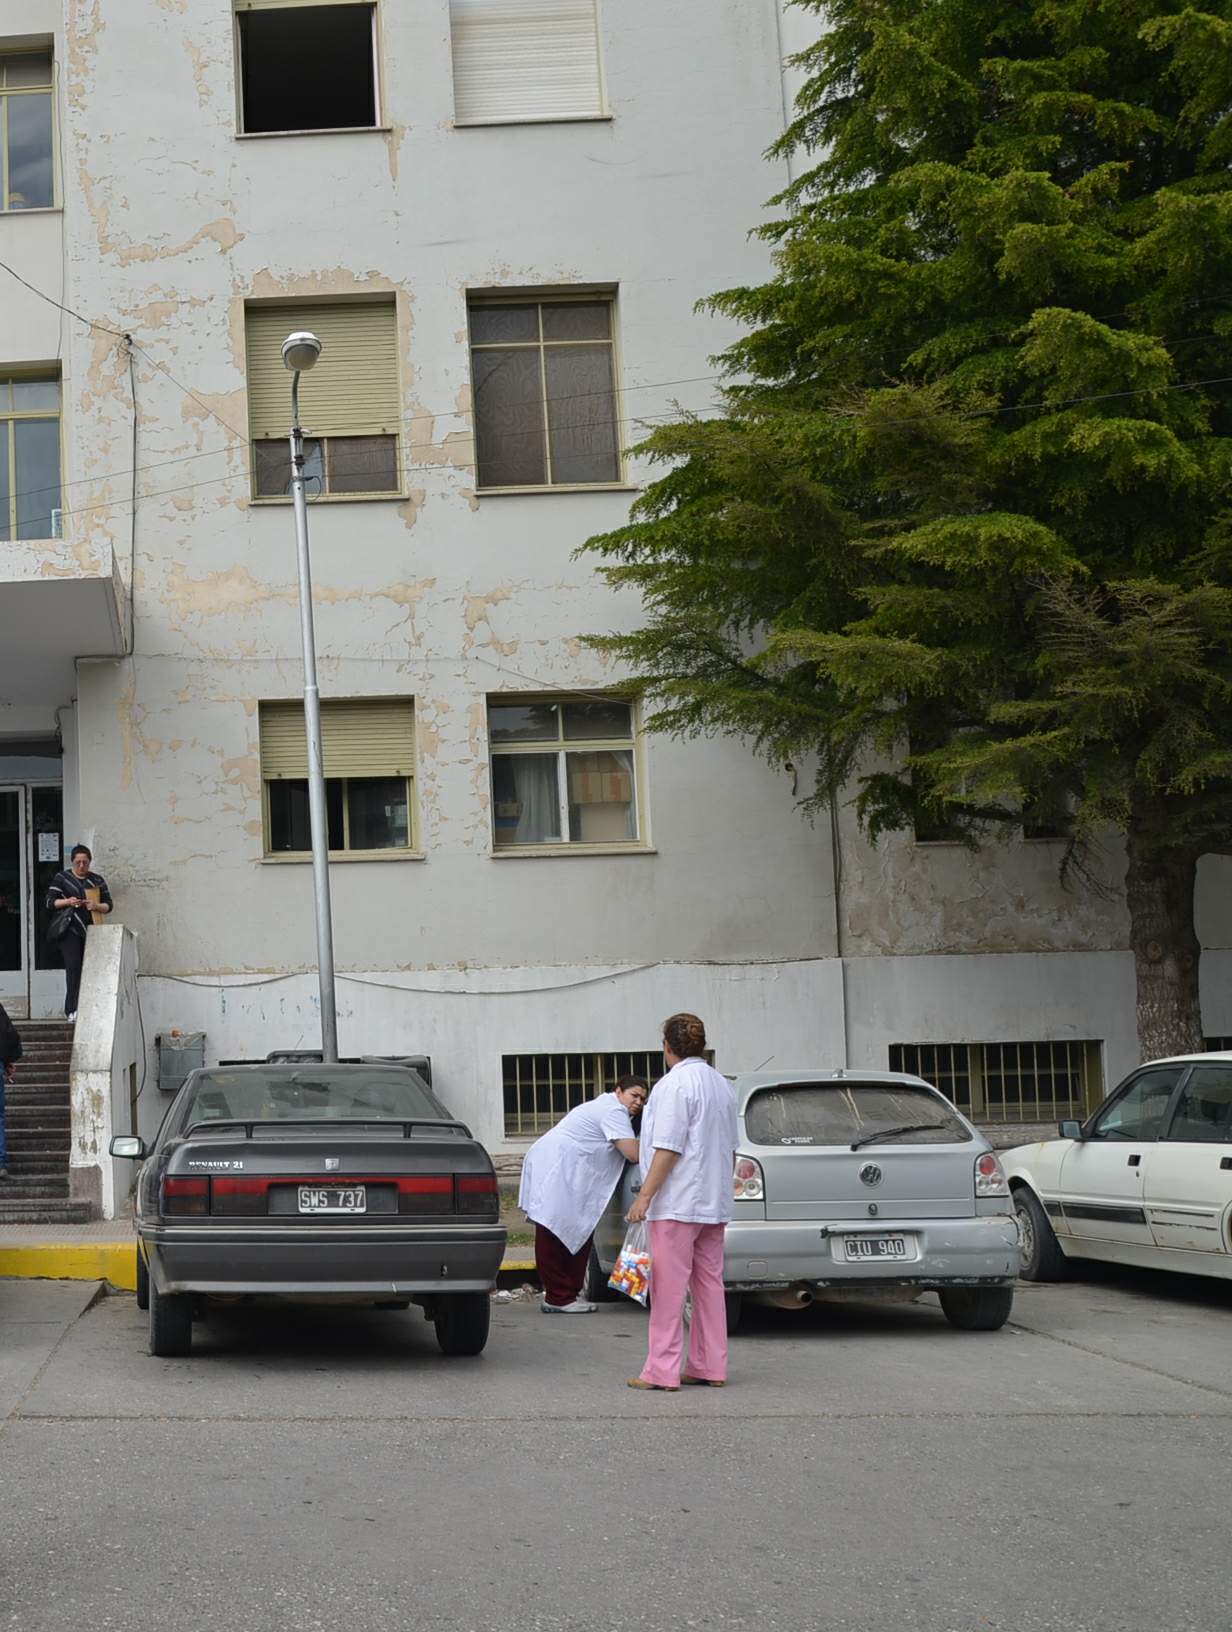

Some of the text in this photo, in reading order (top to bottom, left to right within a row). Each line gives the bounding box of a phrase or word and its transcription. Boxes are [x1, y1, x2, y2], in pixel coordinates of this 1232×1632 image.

[188, 1161, 244, 1169] RENAULT 21
[301, 1191, 363, 1207] SWS 737
[847, 1240, 904, 1256] CIU 940
